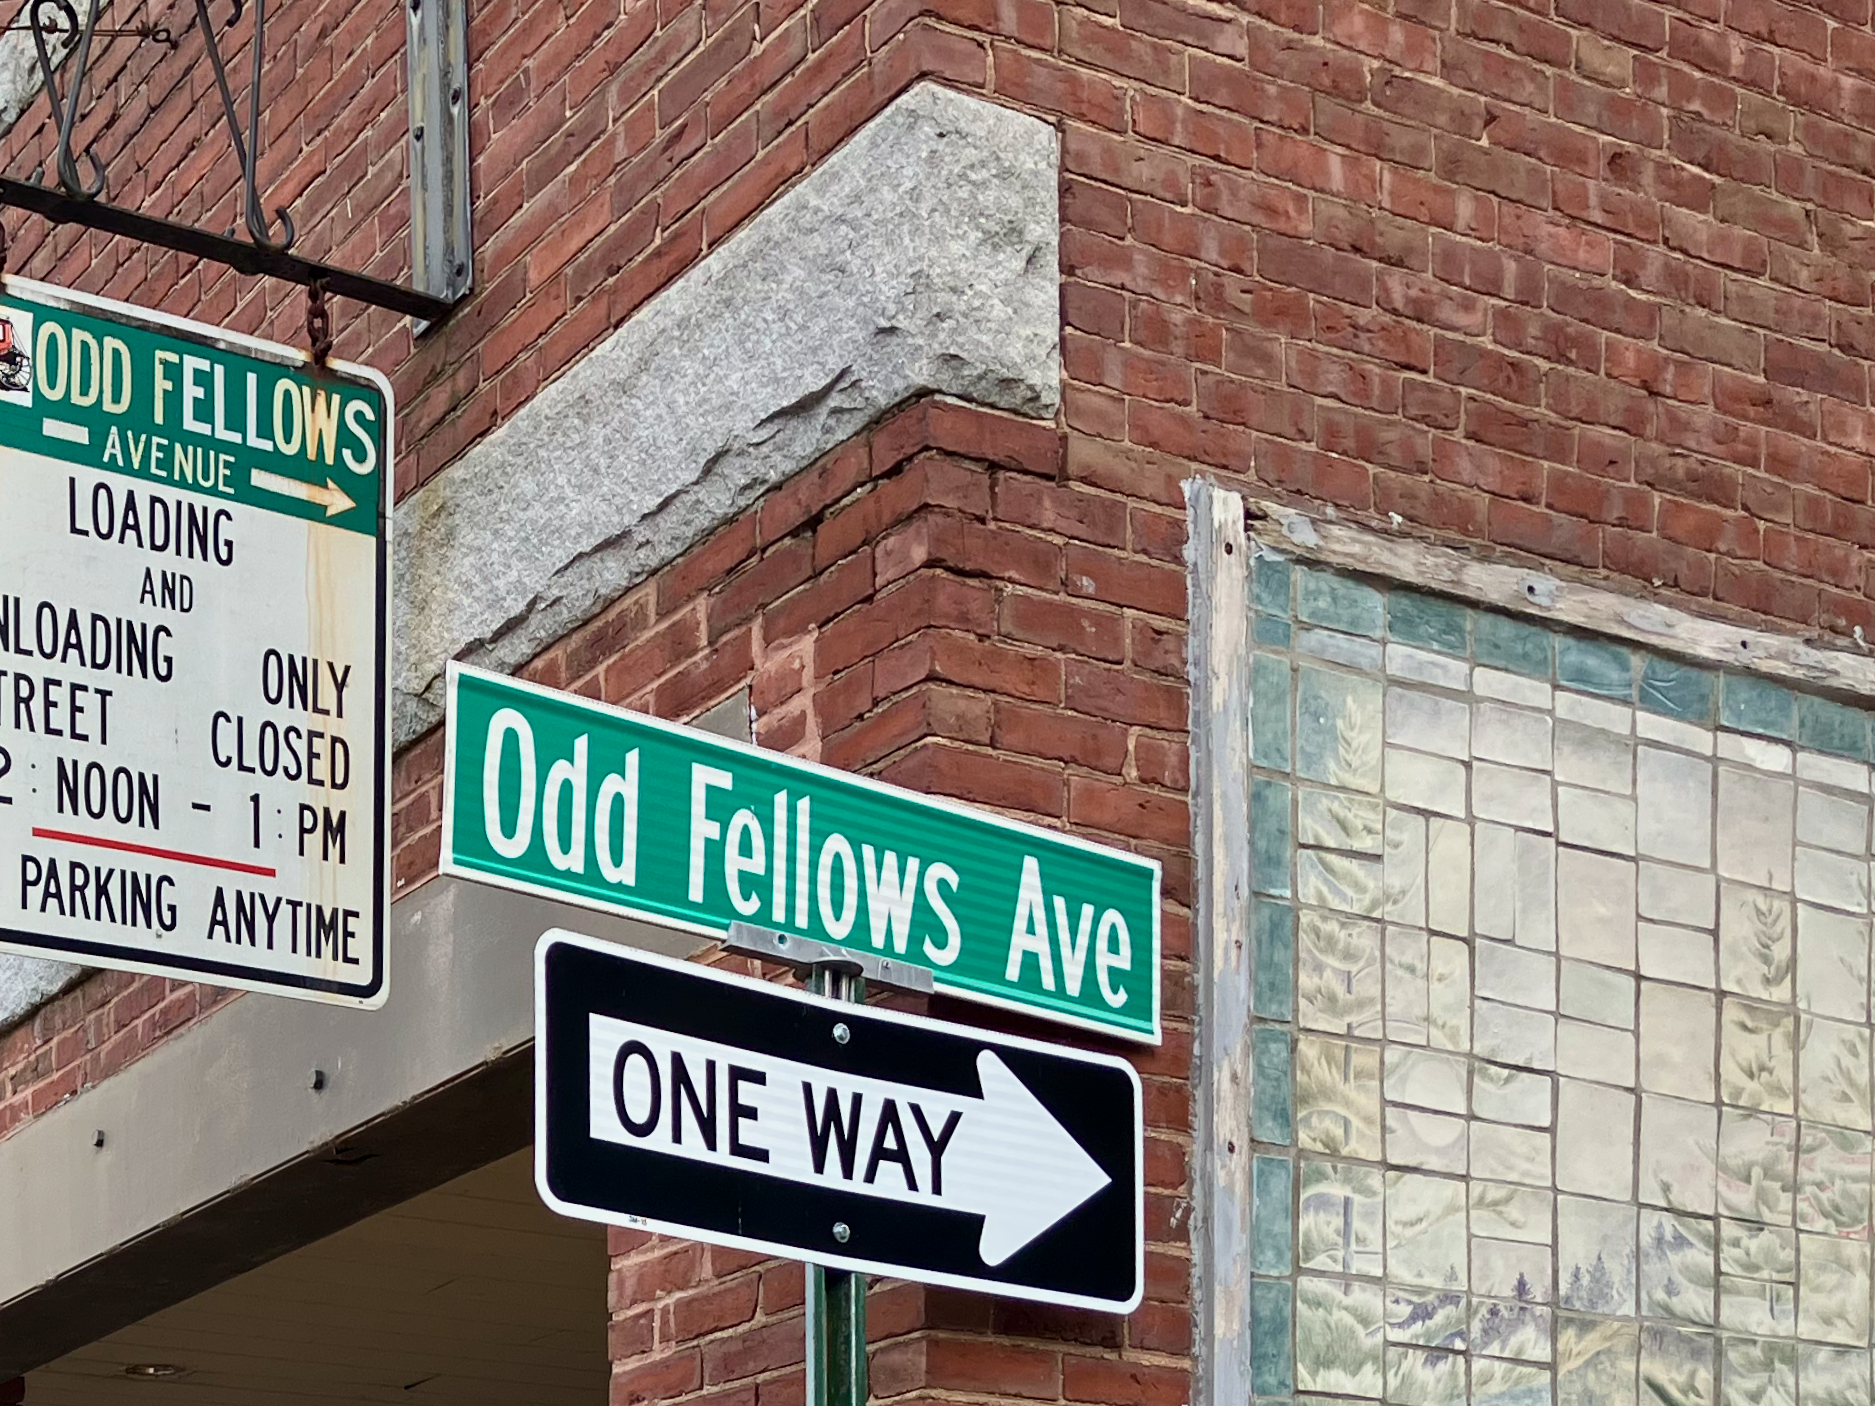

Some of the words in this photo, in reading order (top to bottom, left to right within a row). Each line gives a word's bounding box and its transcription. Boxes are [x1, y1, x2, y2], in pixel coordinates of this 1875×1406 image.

[35, 319, 134, 415] ODD
[153, 349, 378, 475] FELLOWS
[102, 430, 236, 495] AVENUE
[68, 476, 234, 567] LOADING
[139, 566, 194, 614] AND
[261, 647, 352, 720] ONLY
[56, 757, 160, 830] NOON
[210, 711, 350, 792] CLOSED
[482, 706, 641, 888] Odd
[687, 761, 962, 968] Fellows
[1004, 854, 1133, 1010] Ave
[21, 855, 178, 933] PARKING
[207, 885, 360, 966] ANYTIME
[612, 1039, 770, 1164] ONE
[801, 1080, 964, 1197] WAY
